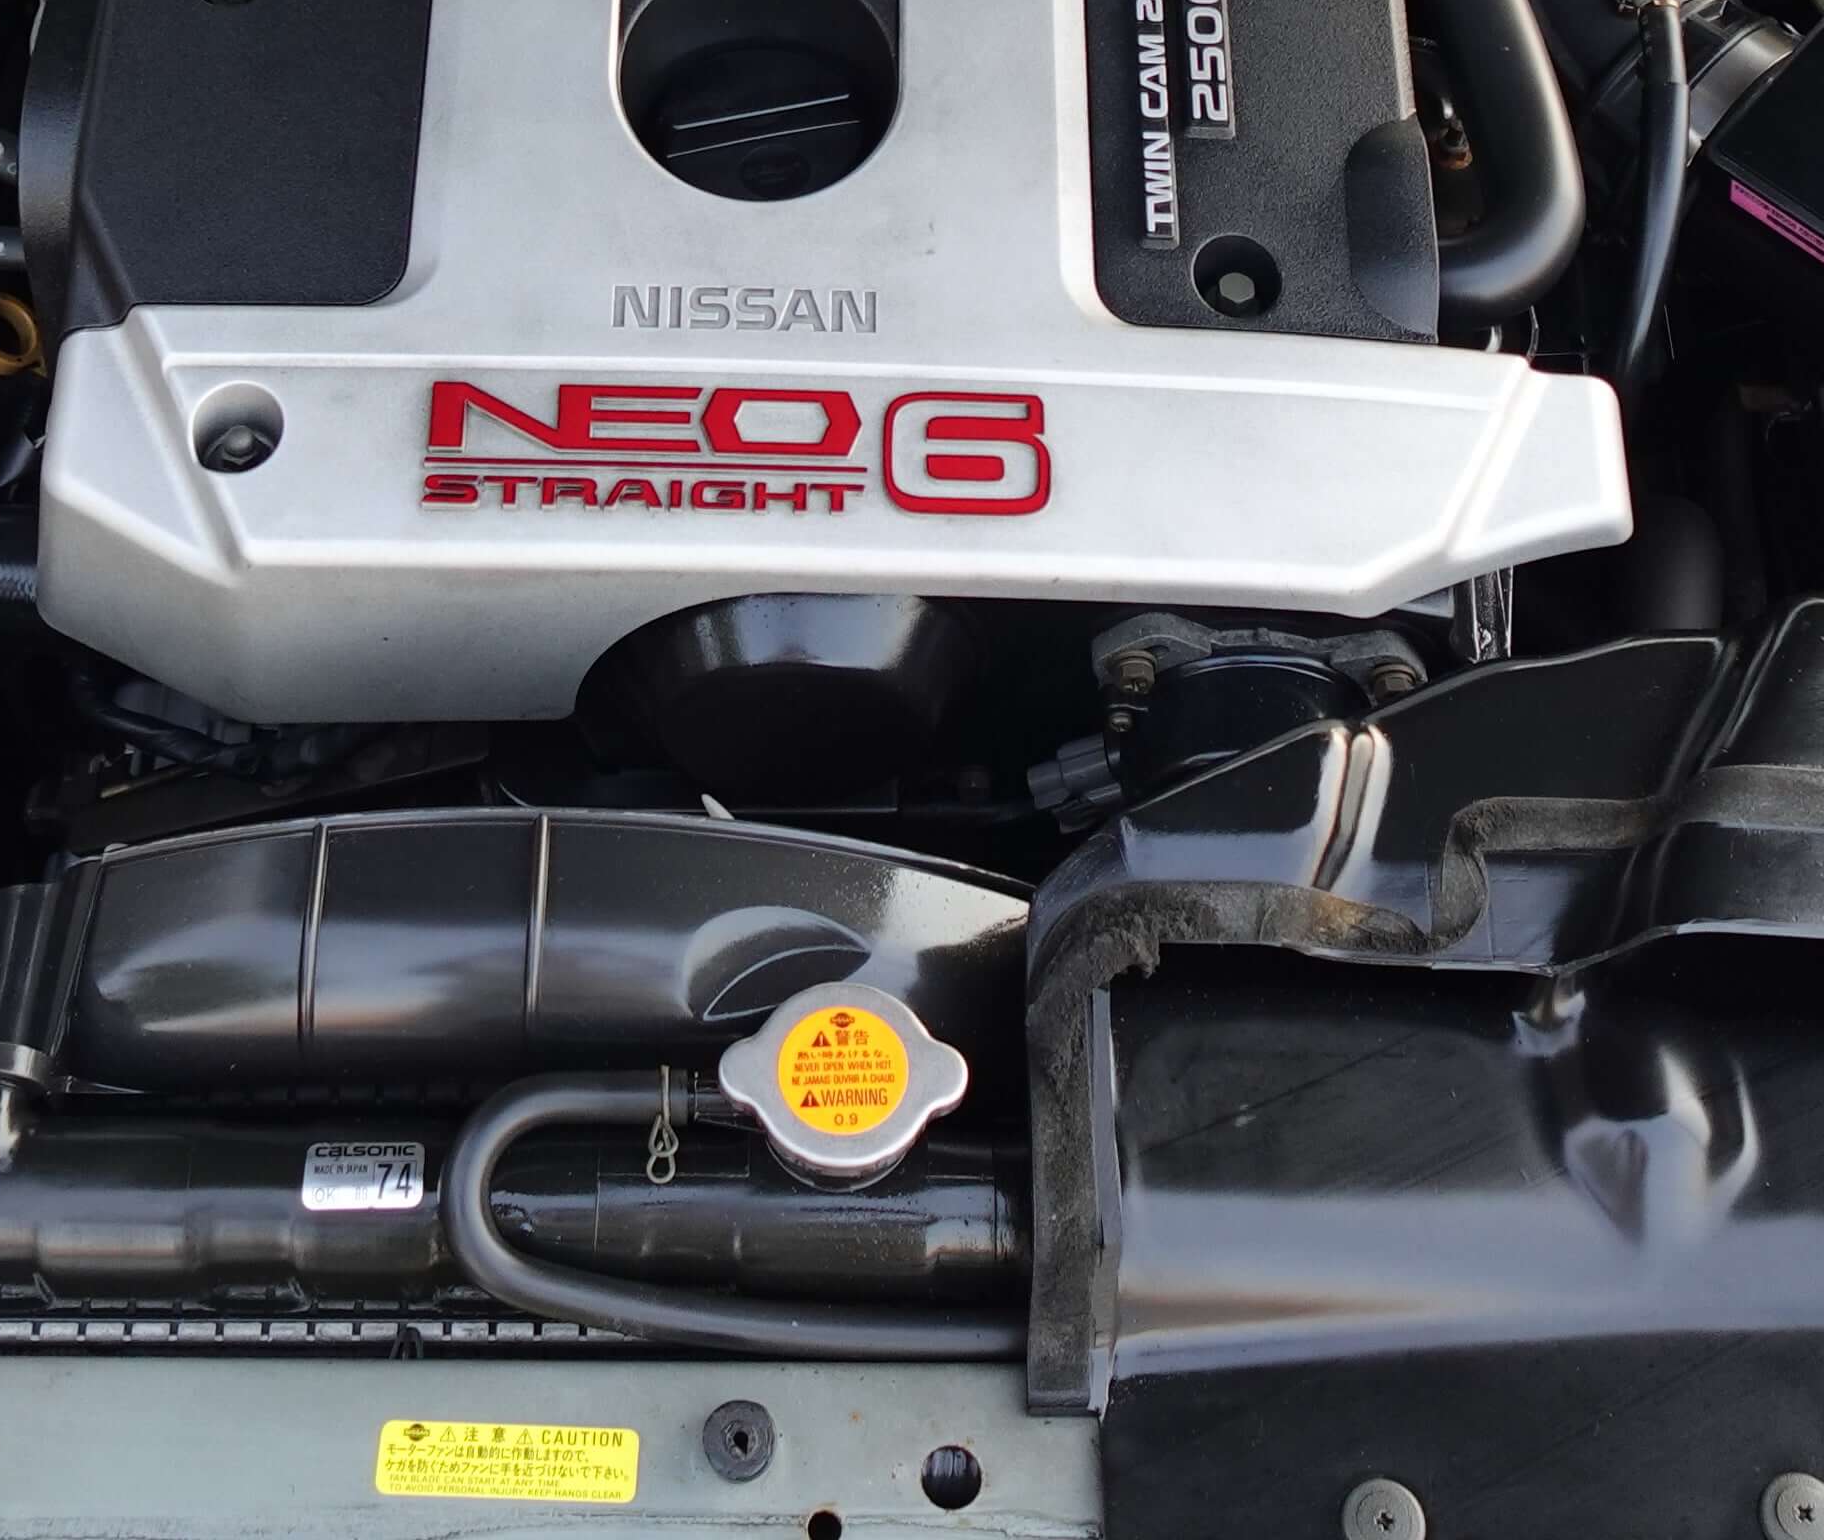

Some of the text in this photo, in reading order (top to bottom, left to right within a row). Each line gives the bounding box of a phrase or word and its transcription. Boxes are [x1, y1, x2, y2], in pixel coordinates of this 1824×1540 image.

[1140, 33, 1168, 120] CAM
[1143, 131, 1175, 237] TWIN
[612, 285, 877, 333] NISSAN
[427, 381, 1052, 515] NEO 6
[421, 473, 866, 515] STRAIGHT
[794, 1061, 873, 1072] NEVER OPEN WHEN
[821, 1088, 888, 1107] WARNING
[833, 1113, 858, 1126] 0.9
[314, 1163, 333, 1174] MADE
[346, 1164, 368, 1174] JAPAN
[377, 1162, 413, 1200] 74
[542, 1429, 623, 1447] CAUTION
[390, 1483, 401, 1492] TO
[437, 1485, 485, 1494] PERSONAL
[444, 1476, 464, 1484] CAN
